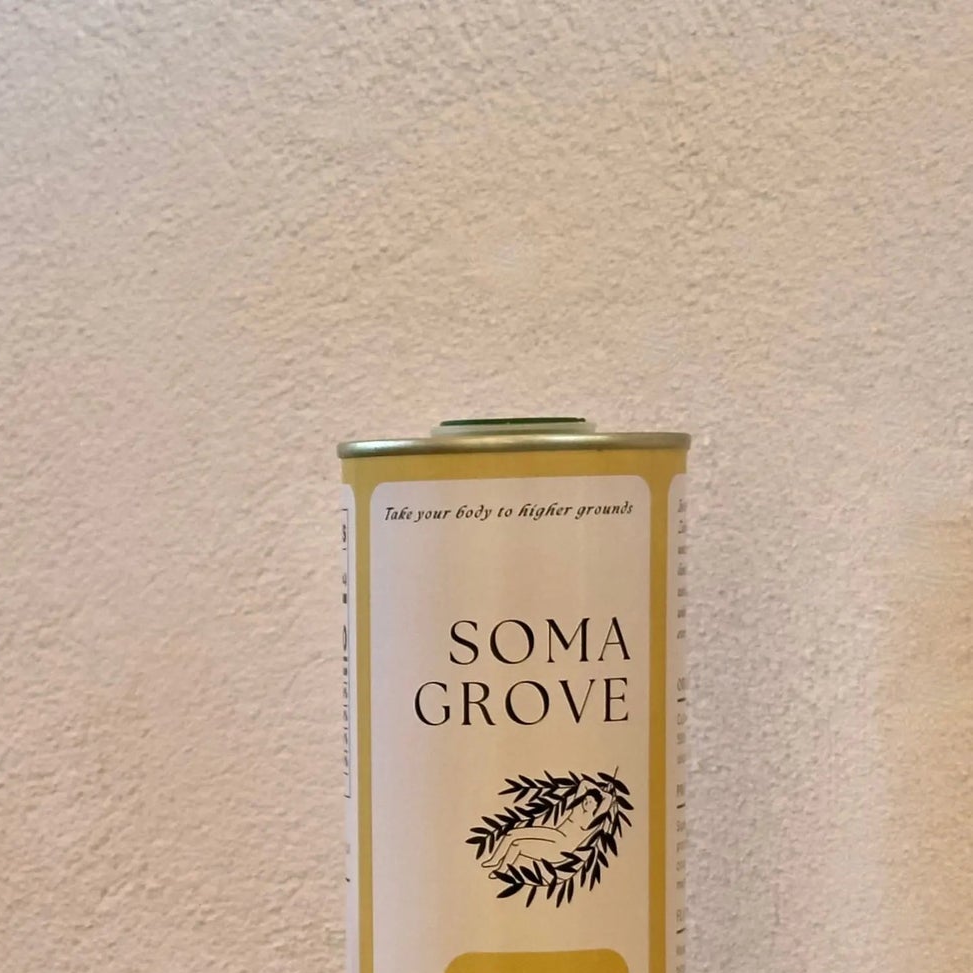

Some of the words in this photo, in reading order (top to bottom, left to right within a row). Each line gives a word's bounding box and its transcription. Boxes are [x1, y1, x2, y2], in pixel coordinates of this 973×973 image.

[384, 506, 413, 521] Take
[413, 509, 452, 523] your
[455, 504, 493, 522] body
[497, 507, 513, 518] to
[517, 502, 573, 521] higher
[574, 500, 634, 520] grounds
[449, 616, 631, 666] SOMA
[414, 677, 629, 727] GROVE
